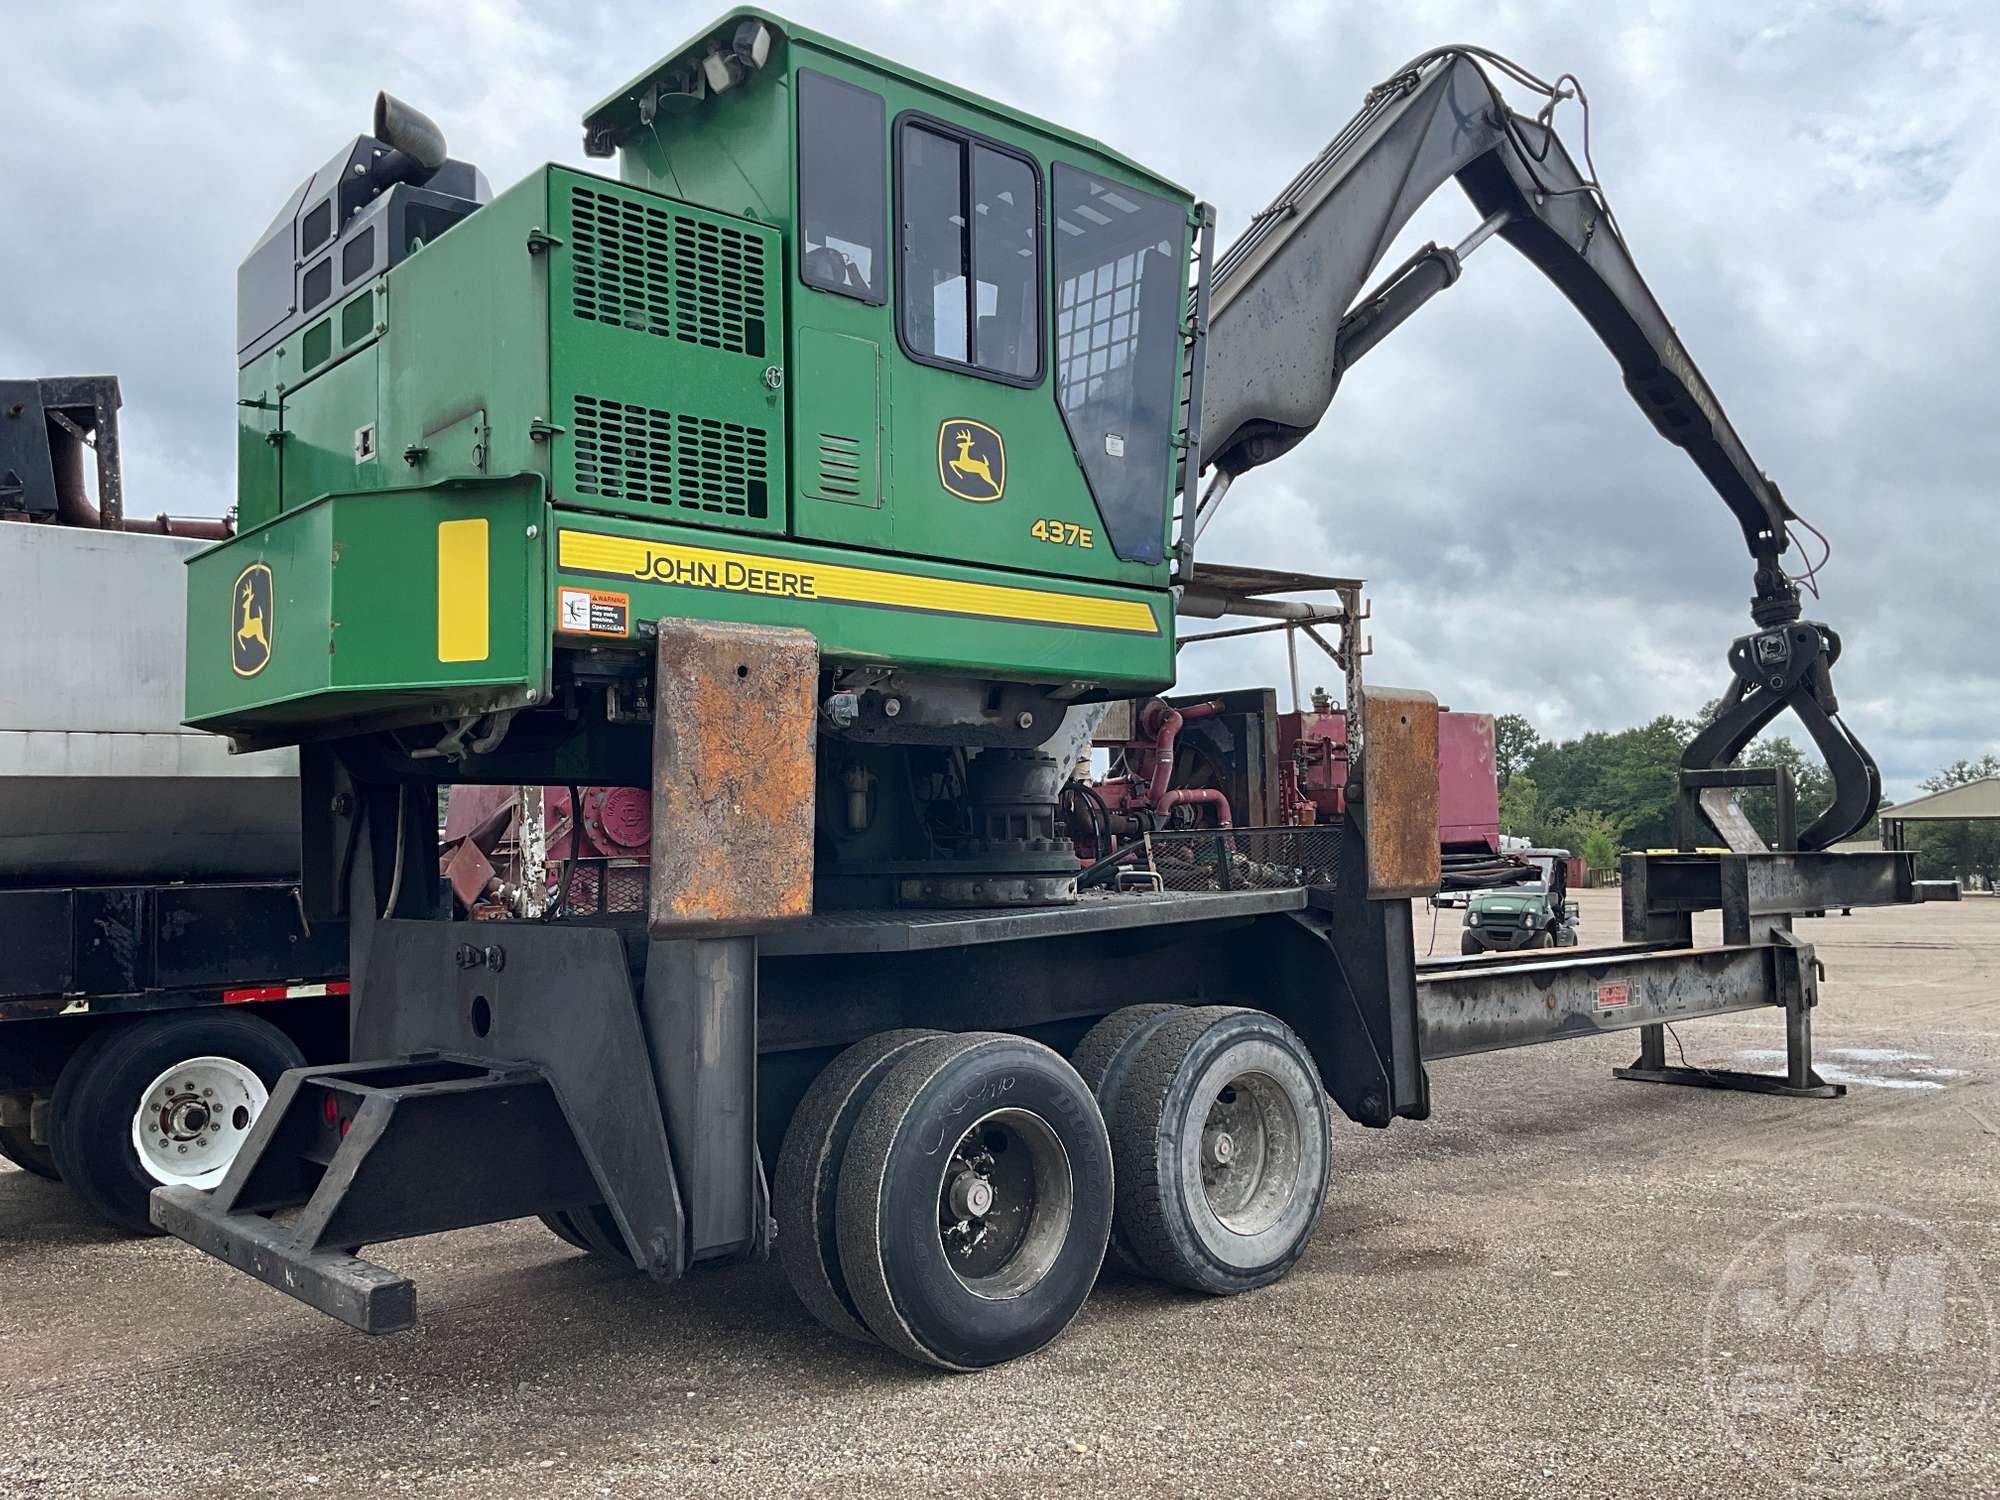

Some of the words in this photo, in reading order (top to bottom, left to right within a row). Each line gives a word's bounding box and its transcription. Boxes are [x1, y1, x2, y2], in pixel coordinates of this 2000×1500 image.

[1031, 519, 1094, 549] 437E
[635, 550, 717, 584] JOHN
[724, 561, 816, 595] DEERE
[597, 595, 625, 603] WARNING
